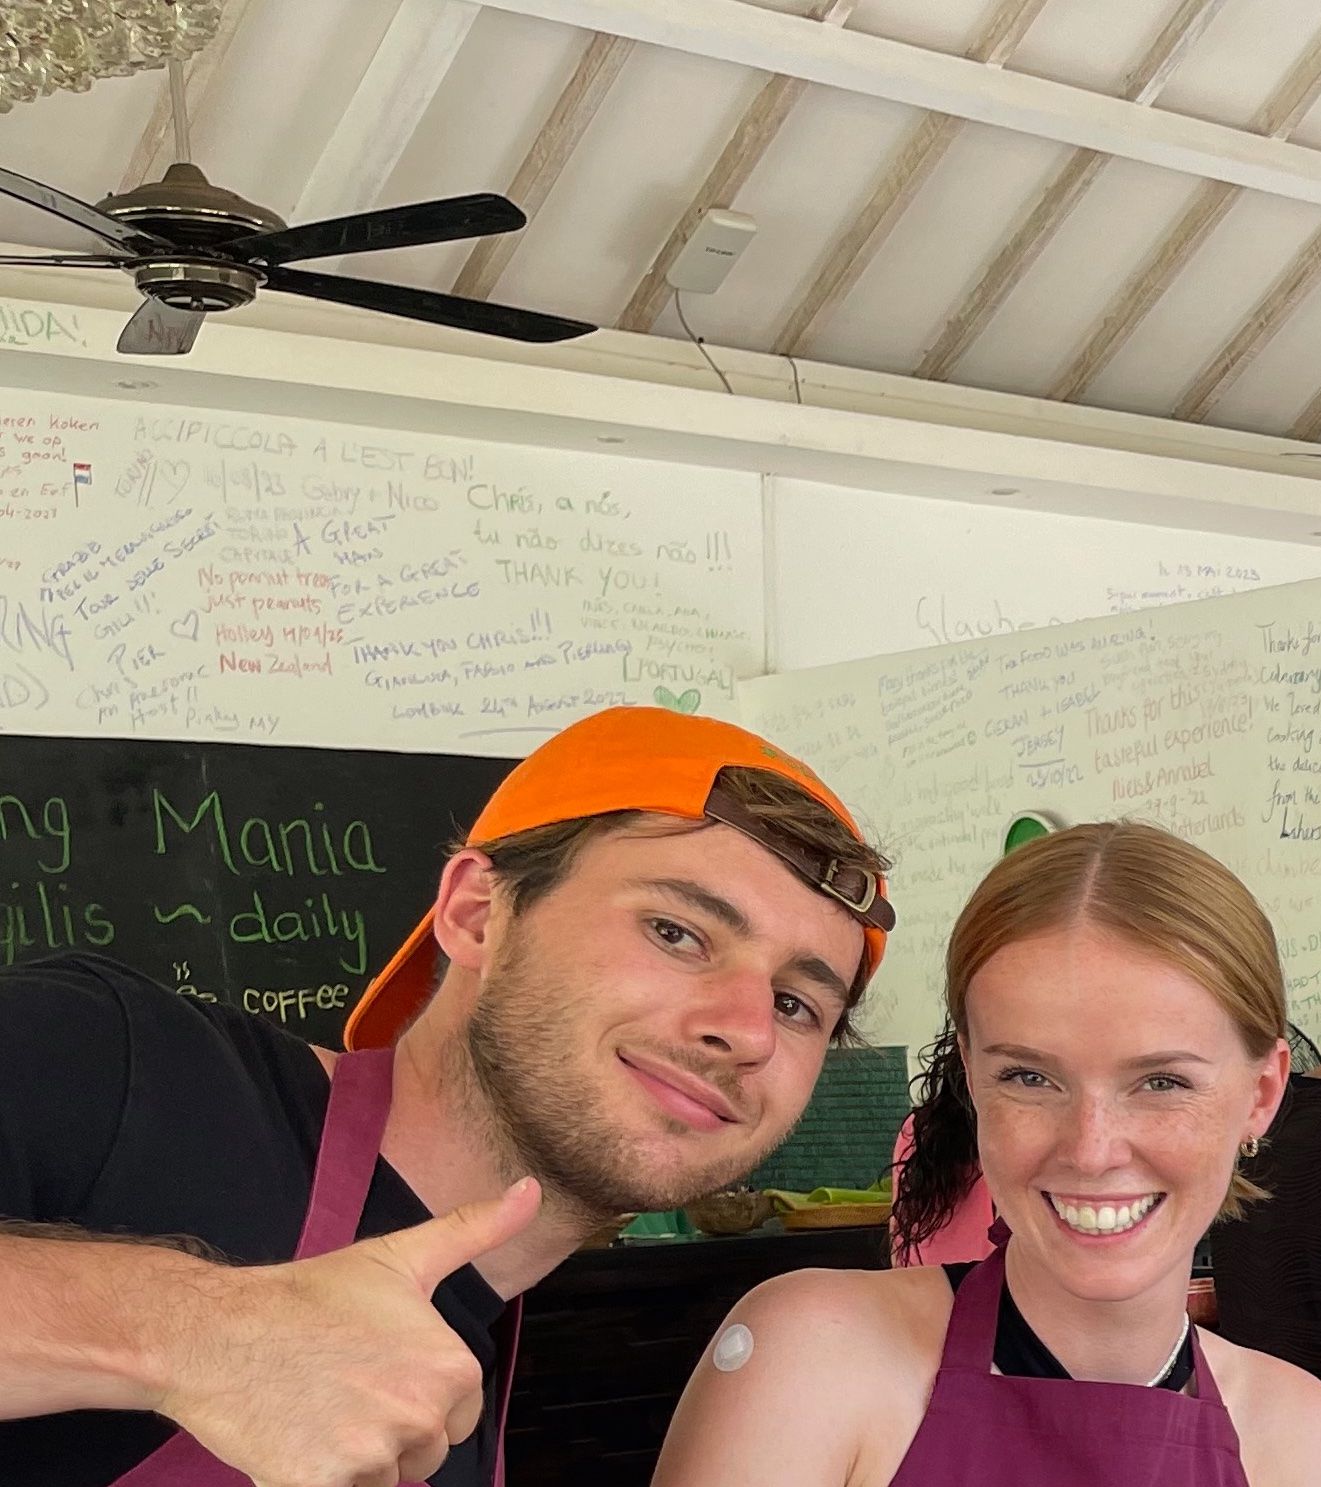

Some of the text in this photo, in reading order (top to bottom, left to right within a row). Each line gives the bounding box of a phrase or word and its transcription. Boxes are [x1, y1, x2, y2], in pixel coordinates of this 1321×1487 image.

[495, 559, 583, 587] THANK
[153, 788, 387, 876] Mania
[230, 891, 367, 975] daily
